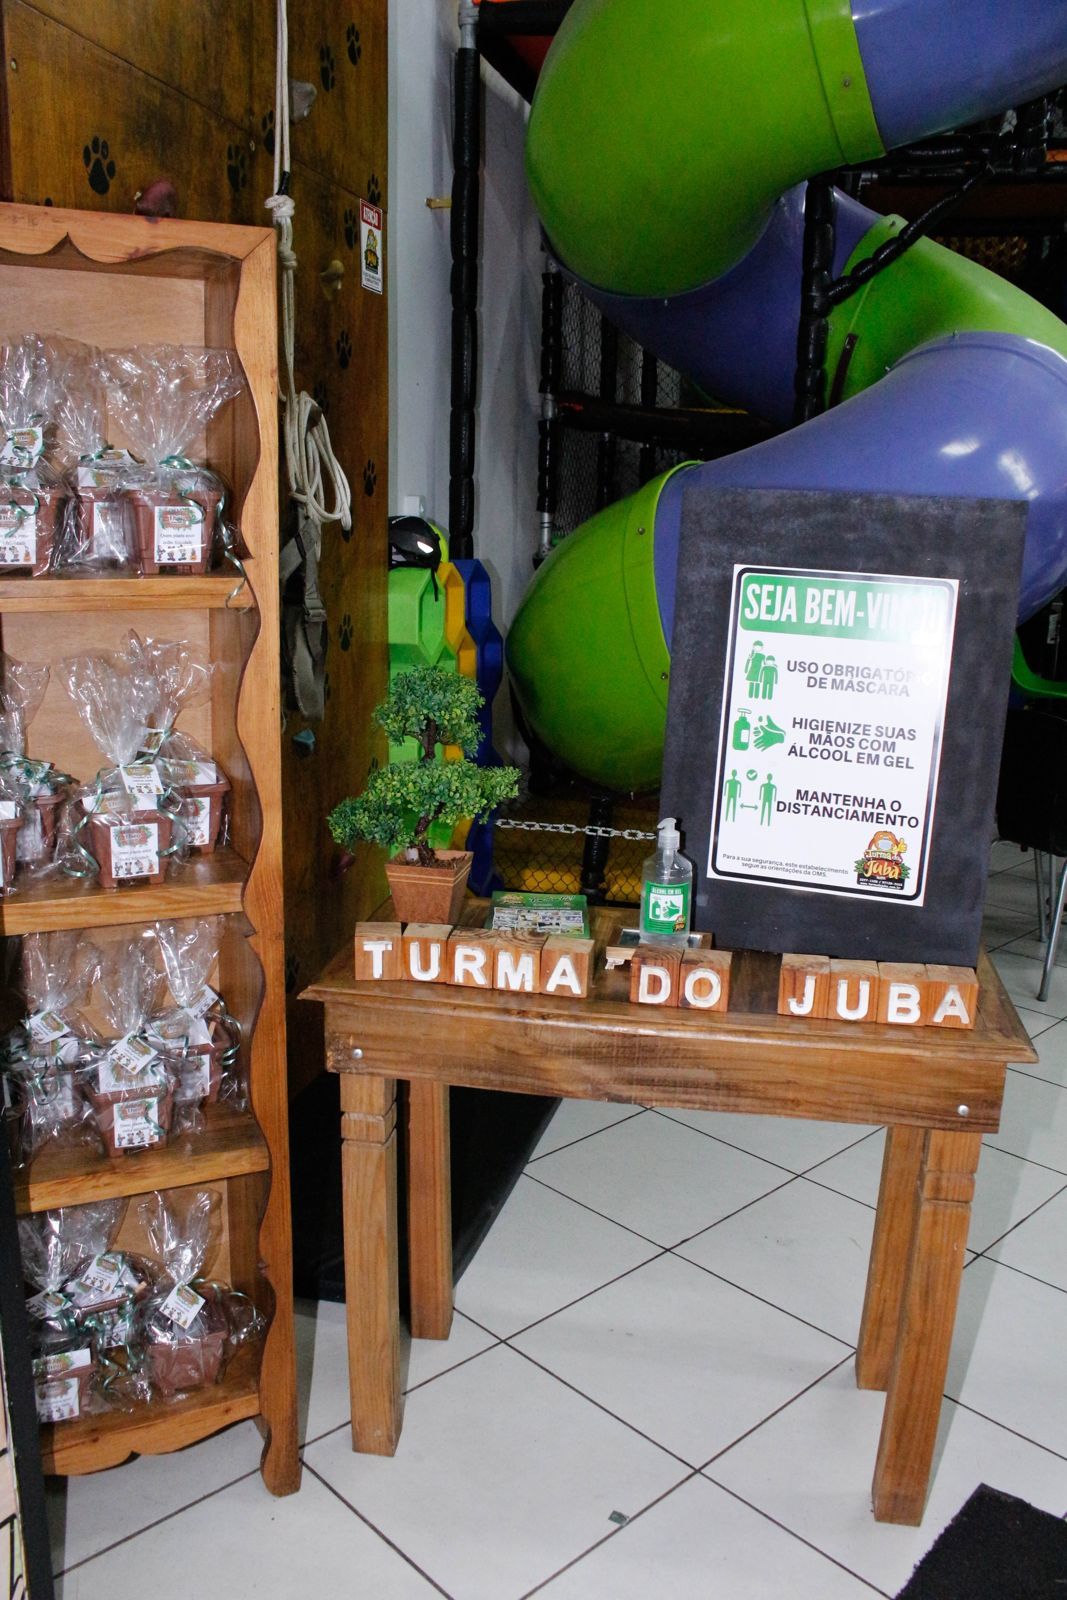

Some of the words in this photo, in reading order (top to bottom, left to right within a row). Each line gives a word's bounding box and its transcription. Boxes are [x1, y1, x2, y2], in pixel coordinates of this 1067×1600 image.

[744, 583, 797, 622] SEJA
[787, 660, 818, 674] USO
[807, 676, 828, 689] DE
[831, 676, 910, 698] MÁSCARA
[792, 717, 872, 736] HIGIENIZE
[875, 725, 917, 741] SUAS
[809, 731, 855, 748] MÃOS
[858, 738, 896, 753] COM
[788, 742, 853, 762] ÁLCOOL
[856, 752, 880, 766] EM
[883, 755, 914, 770] GEL
[796, 789, 886, 811] MANTENHA
[890, 800, 902, 812] O
[776, 800, 919, 828] DISTANCIAMENTO
[768, 864, 802, 875] orientações
[798, 863, 848, 875] estabelecimento
[864, 860, 900, 879] Juba
[363, 941, 581, 995] TURMA
[639, 965, 721, 1008] DO
[788, 975, 970, 1025] JUBA
